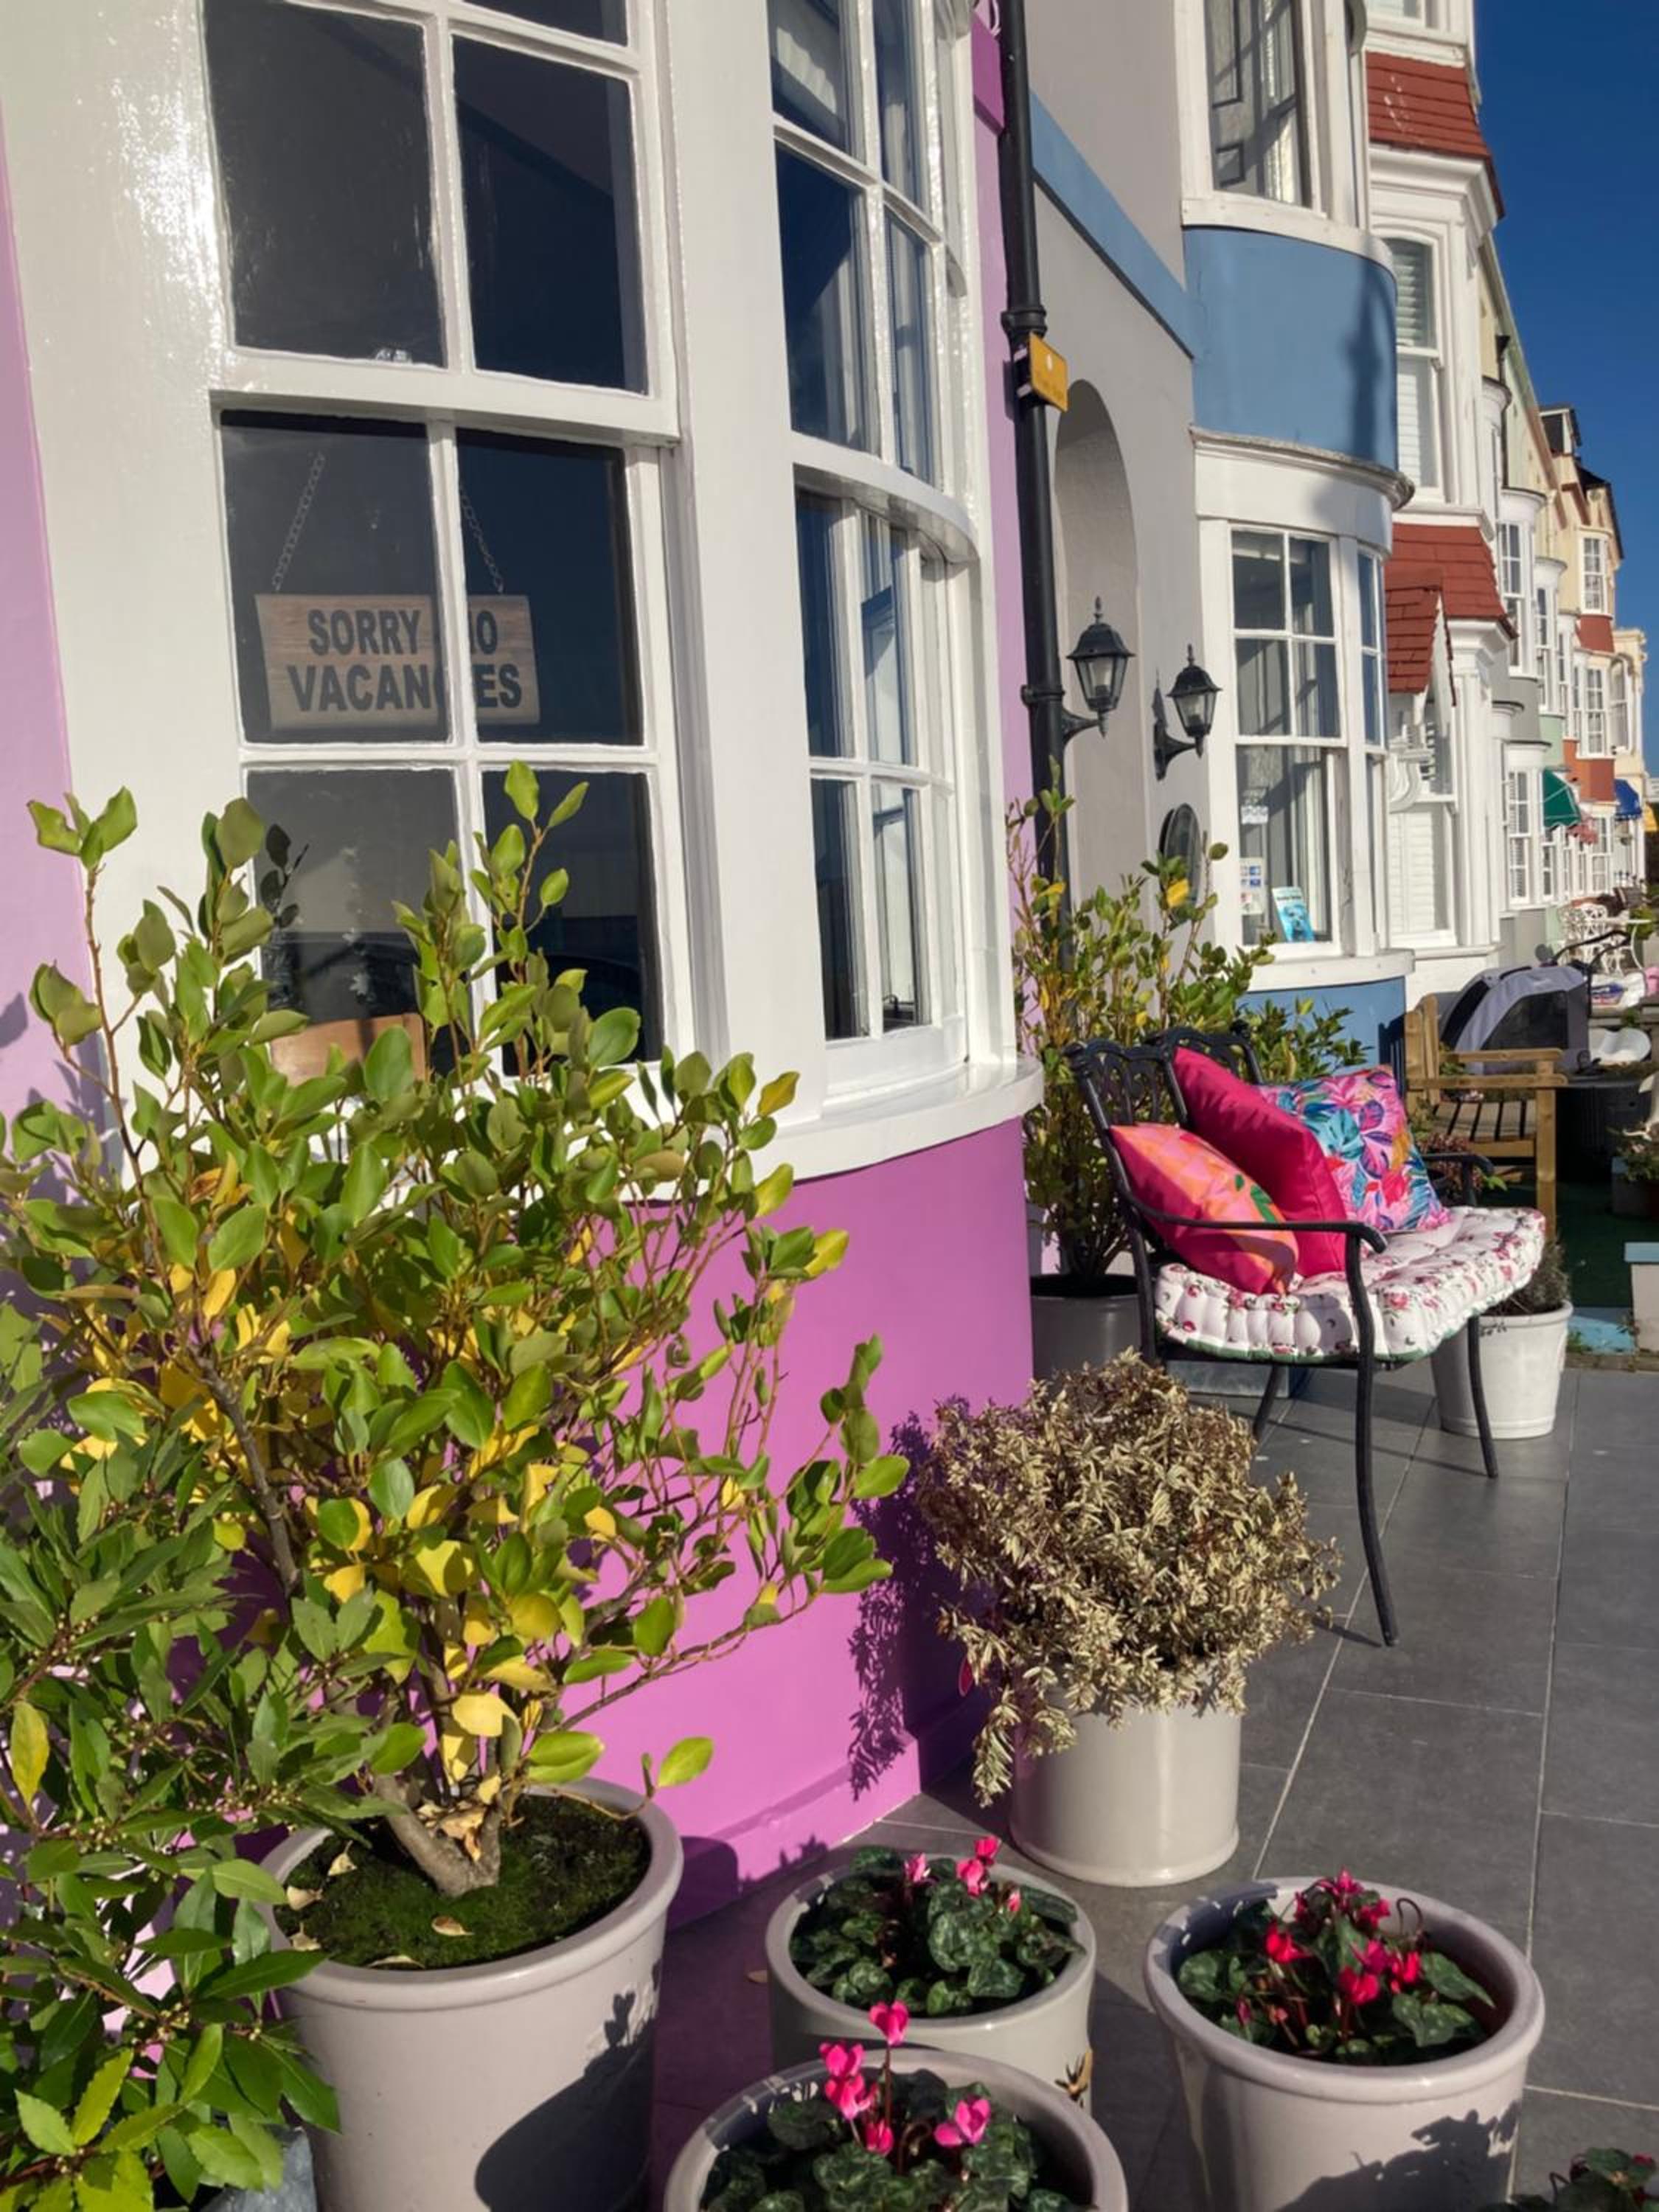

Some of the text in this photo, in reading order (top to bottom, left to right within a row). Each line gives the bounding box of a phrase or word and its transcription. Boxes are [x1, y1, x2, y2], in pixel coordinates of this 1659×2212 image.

[307, 609, 498, 655] SORRY O
[287, 663, 522, 712] VACANES
